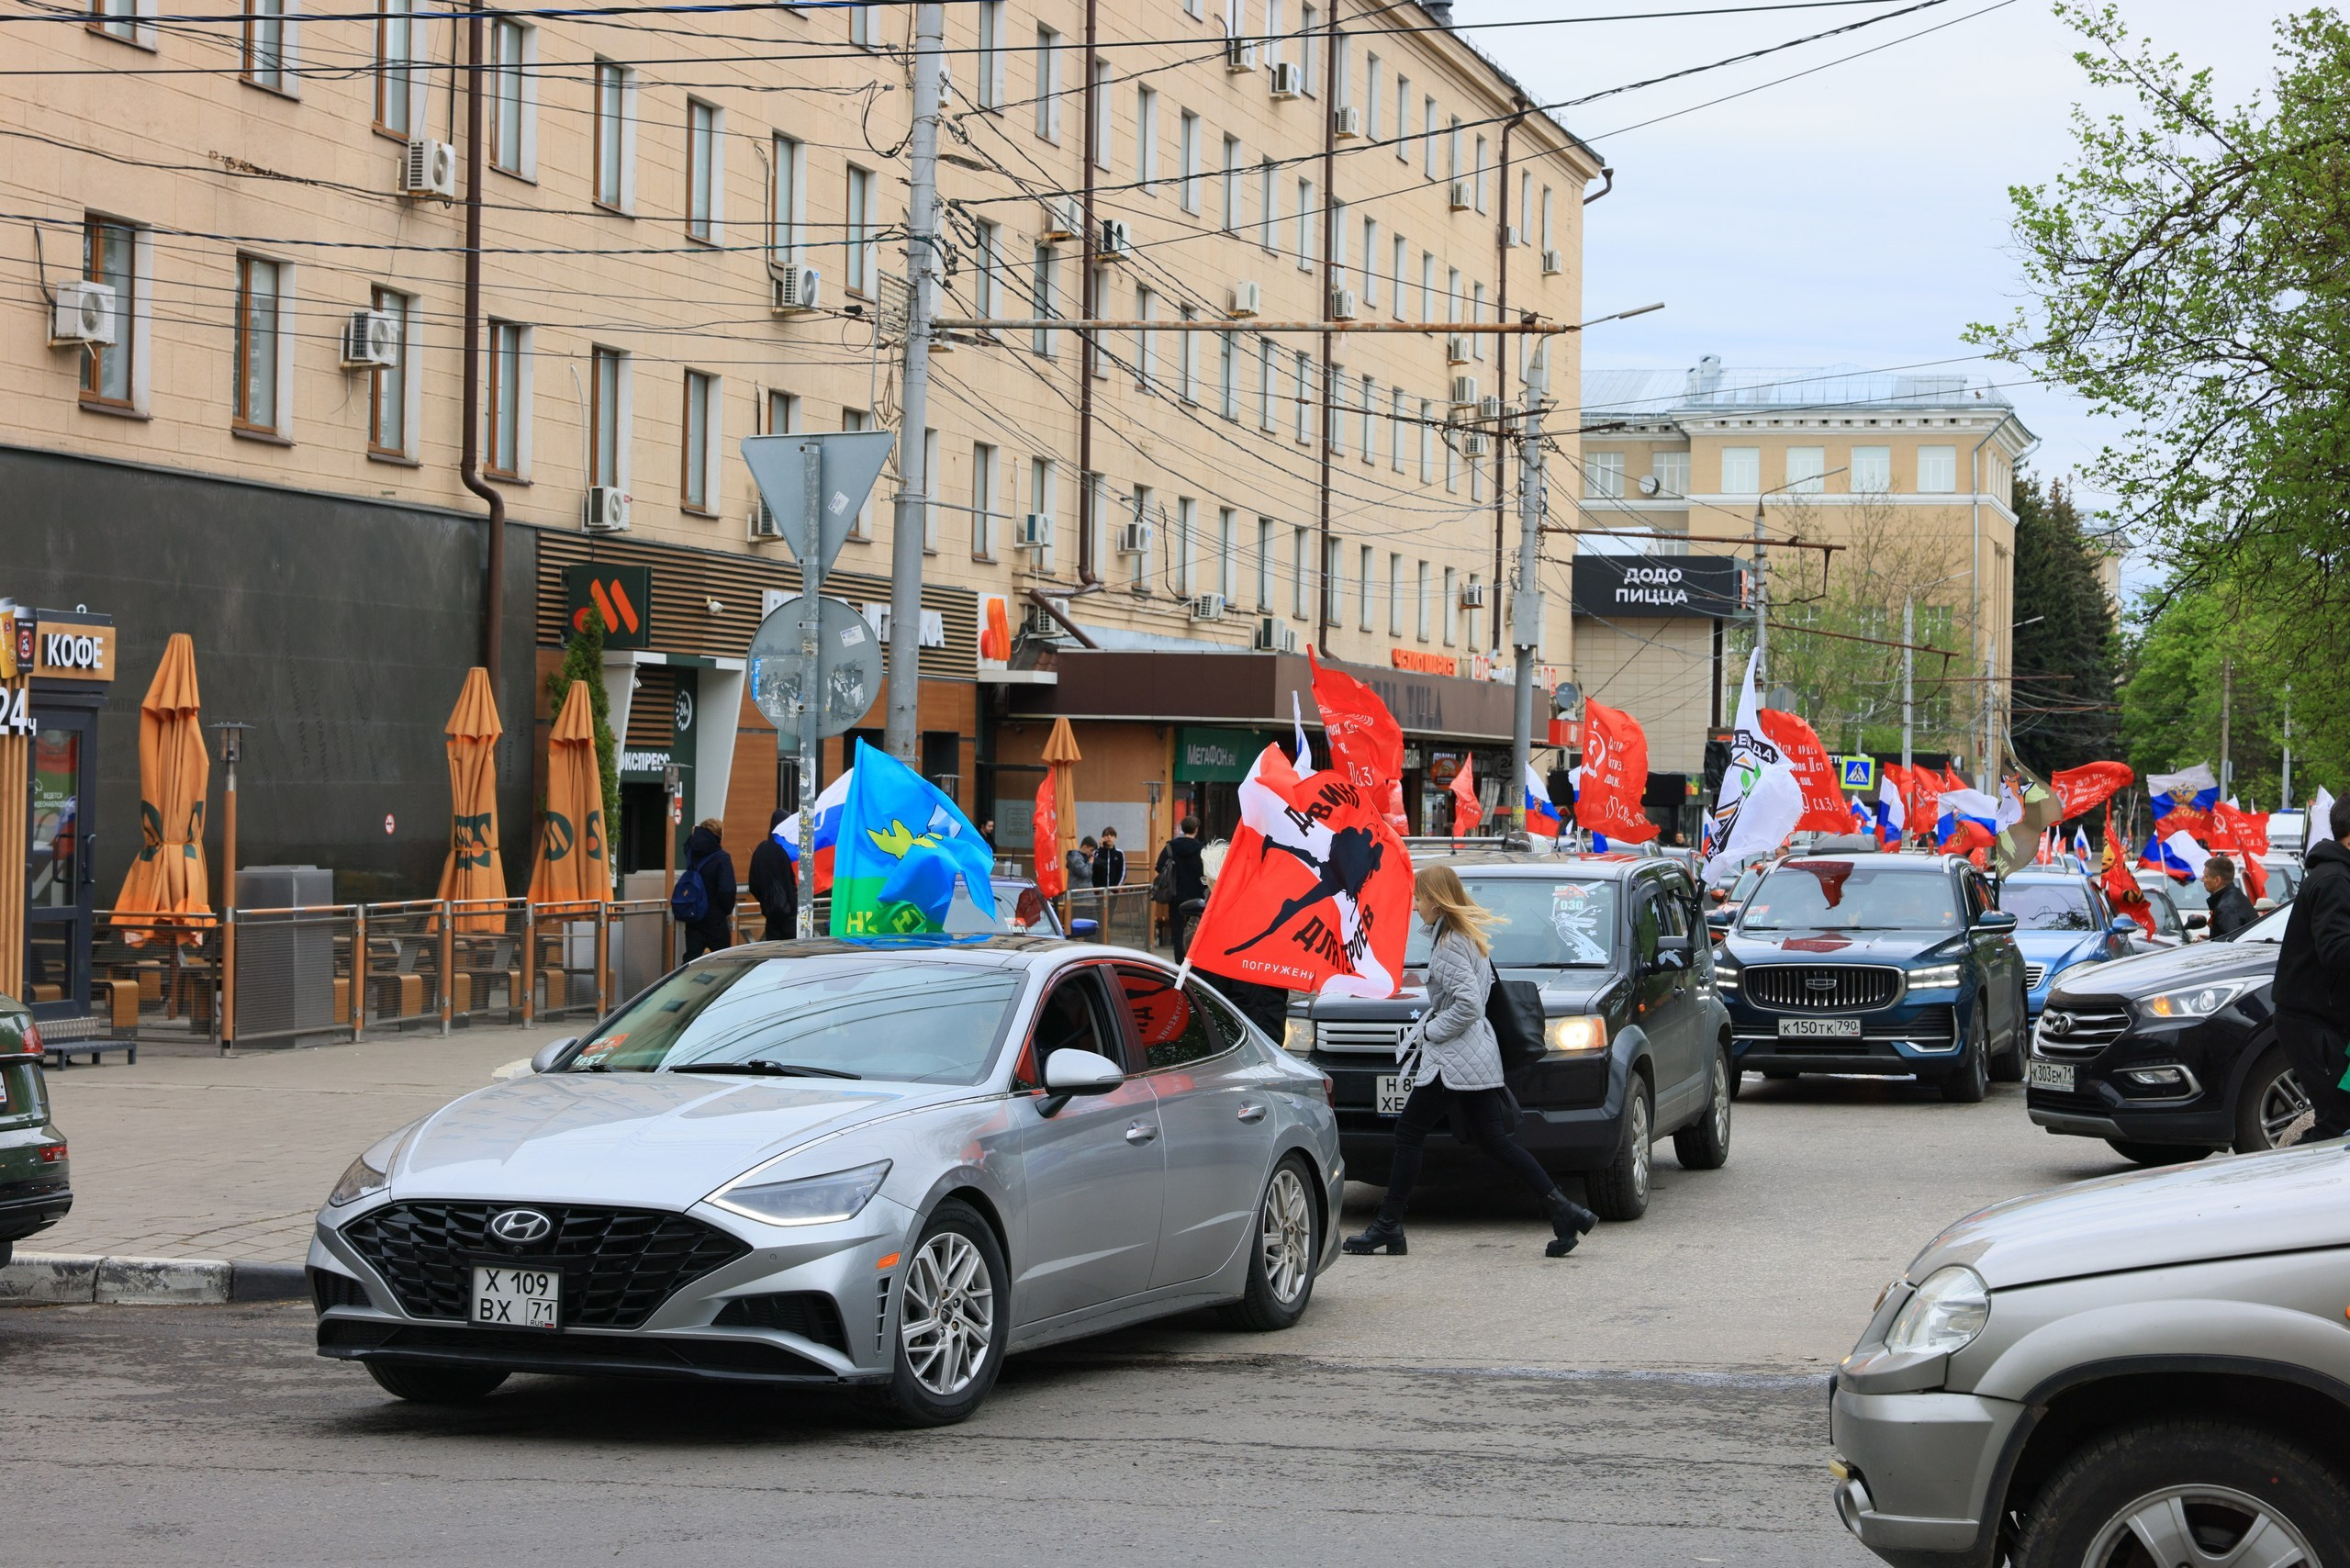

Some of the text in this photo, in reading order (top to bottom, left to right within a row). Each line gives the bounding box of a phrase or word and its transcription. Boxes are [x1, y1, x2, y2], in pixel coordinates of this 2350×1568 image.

[1624, 567, 1683, 586] ДОДО
[1615, 588, 1688, 606] ПИЦЦА
[47, 633, 104, 669] КОФЕ
[0, 687, 37, 735] 24ч
[1292, 914, 1340, 970] ДЛЯ
[1836, 1020, 1857, 1031] 790
[485, 1269, 549, 1296] Х 109
[480, 1297, 553, 1323] ВХ 71
[530, 1319, 544, 1327] RUS
